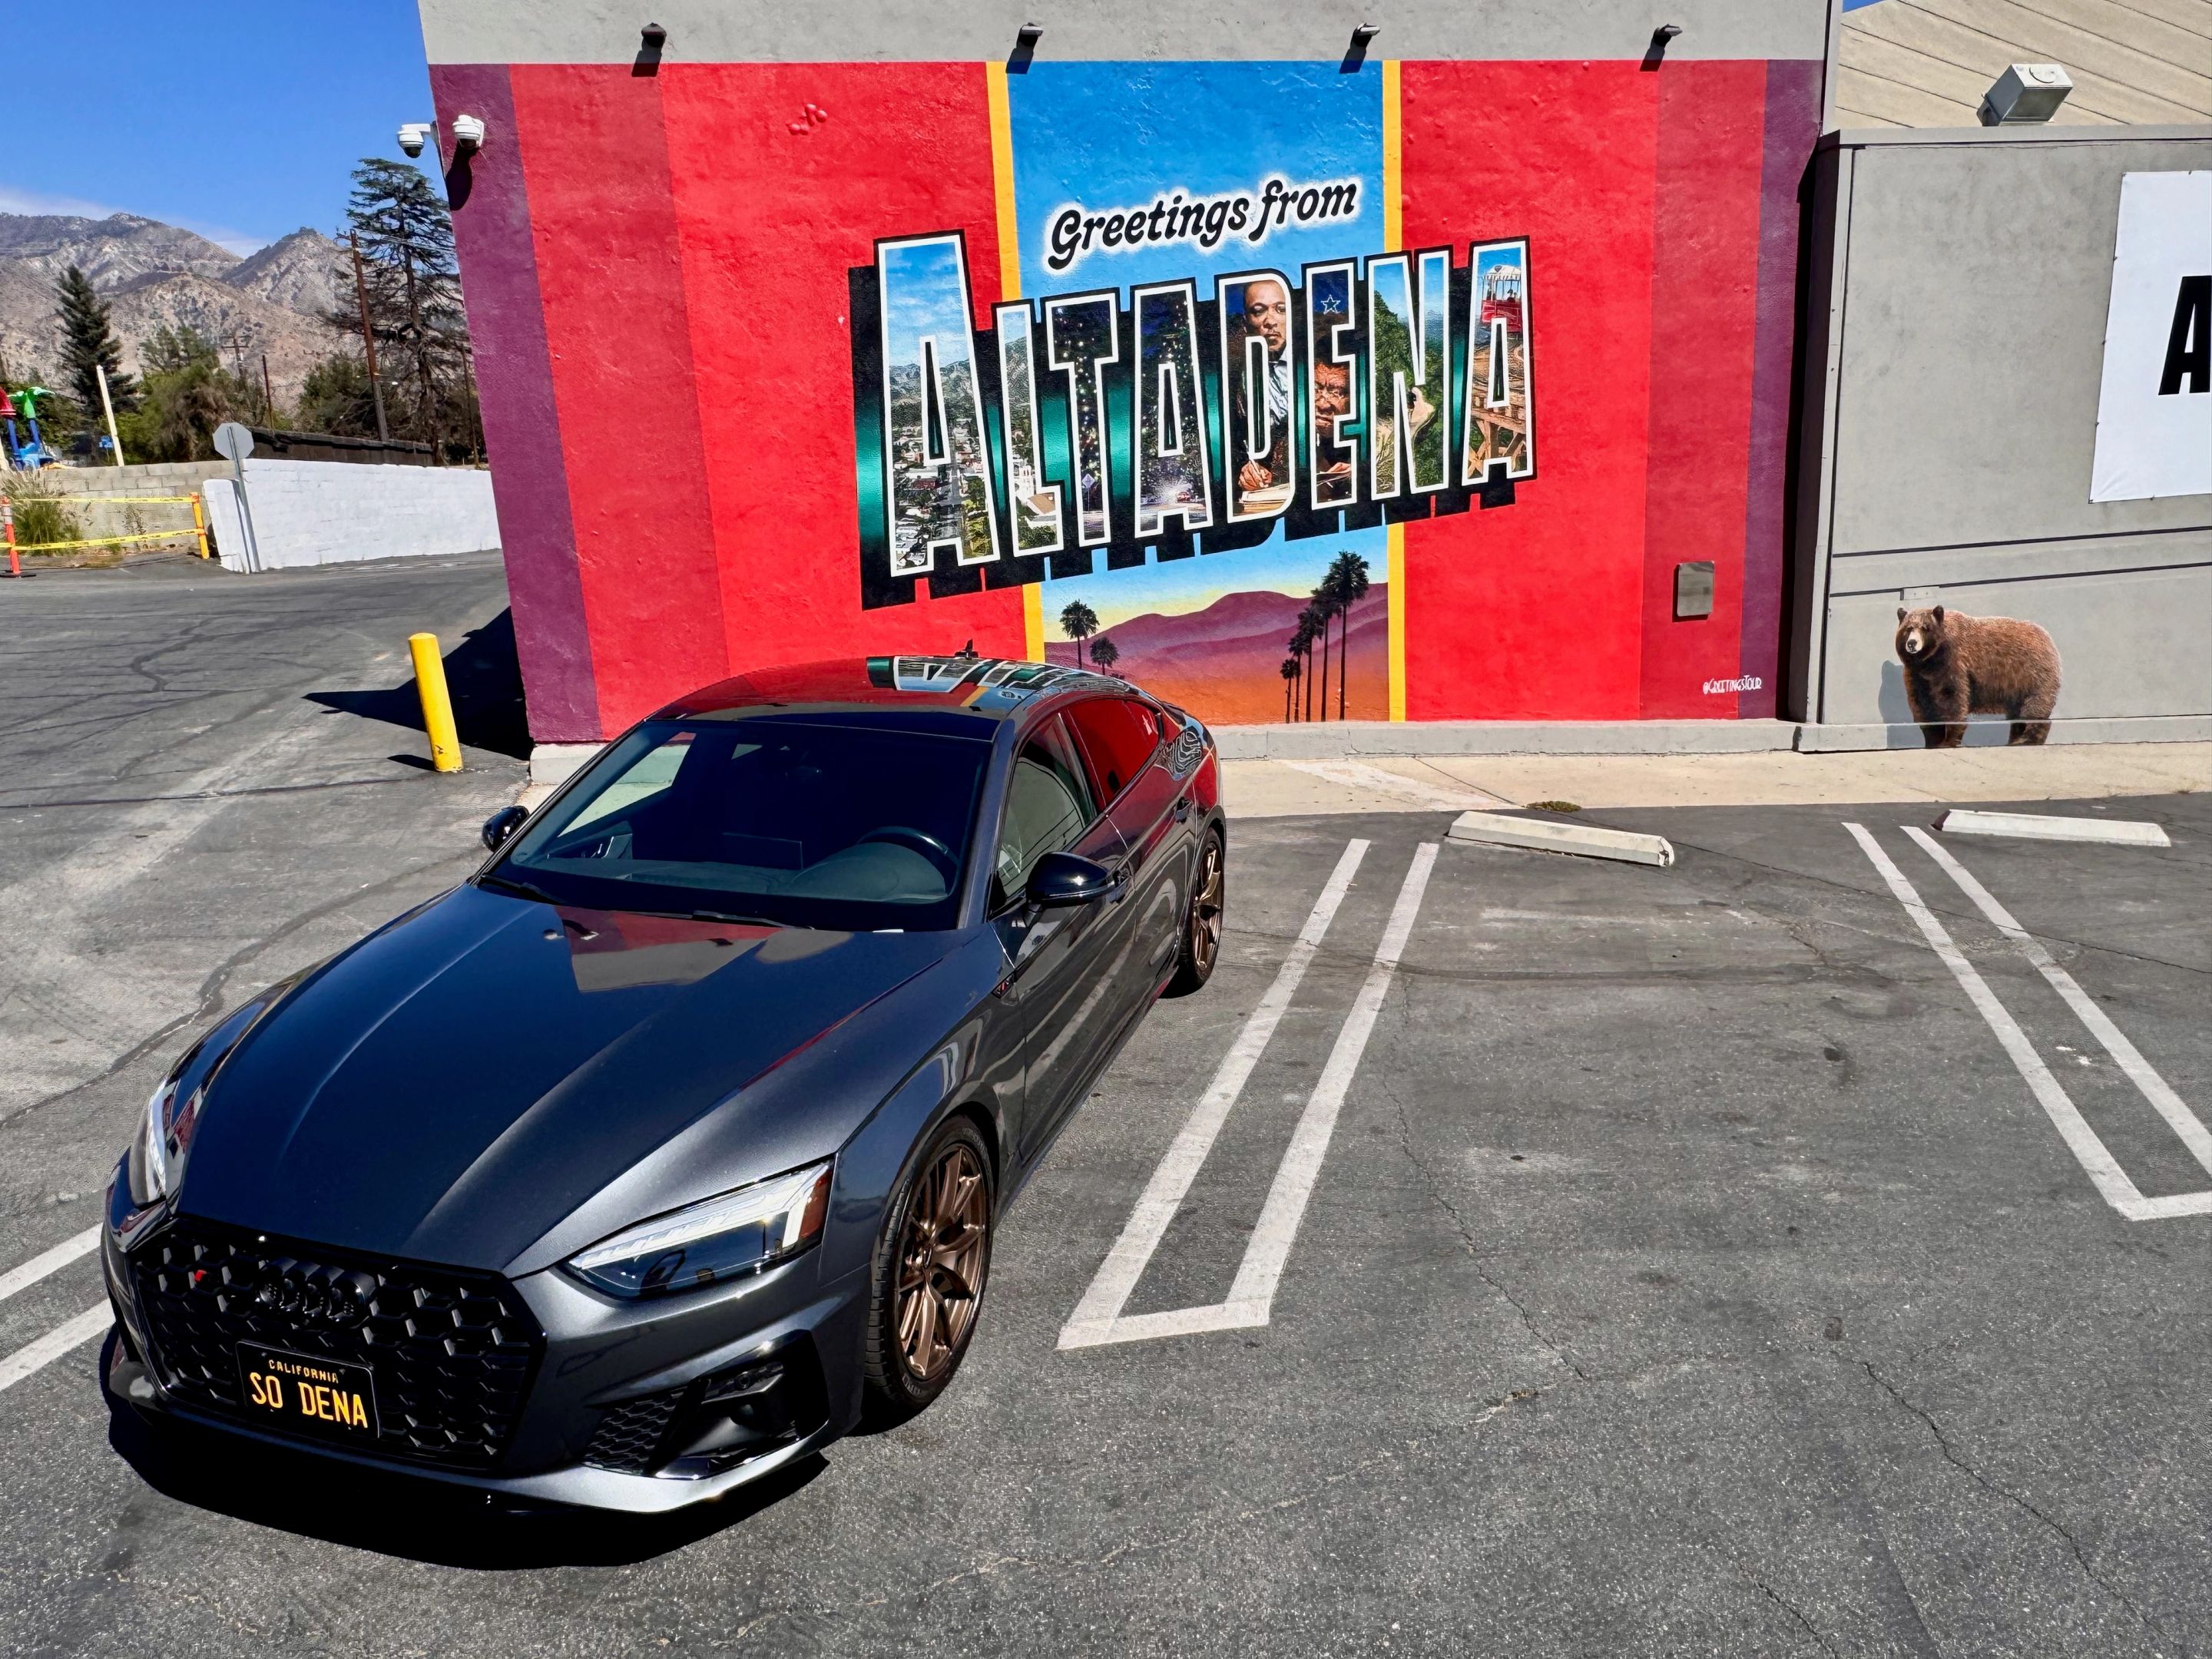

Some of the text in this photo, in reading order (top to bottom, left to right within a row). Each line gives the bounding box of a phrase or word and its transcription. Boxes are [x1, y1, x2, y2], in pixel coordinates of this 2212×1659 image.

[1048, 179, 1357, 270] Greetings from
[874, 233, 1536, 581] ALTADENA
[249, 1372, 369, 1429] SO DENA
[268, 1359, 339, 1384] CALIFORNIA
